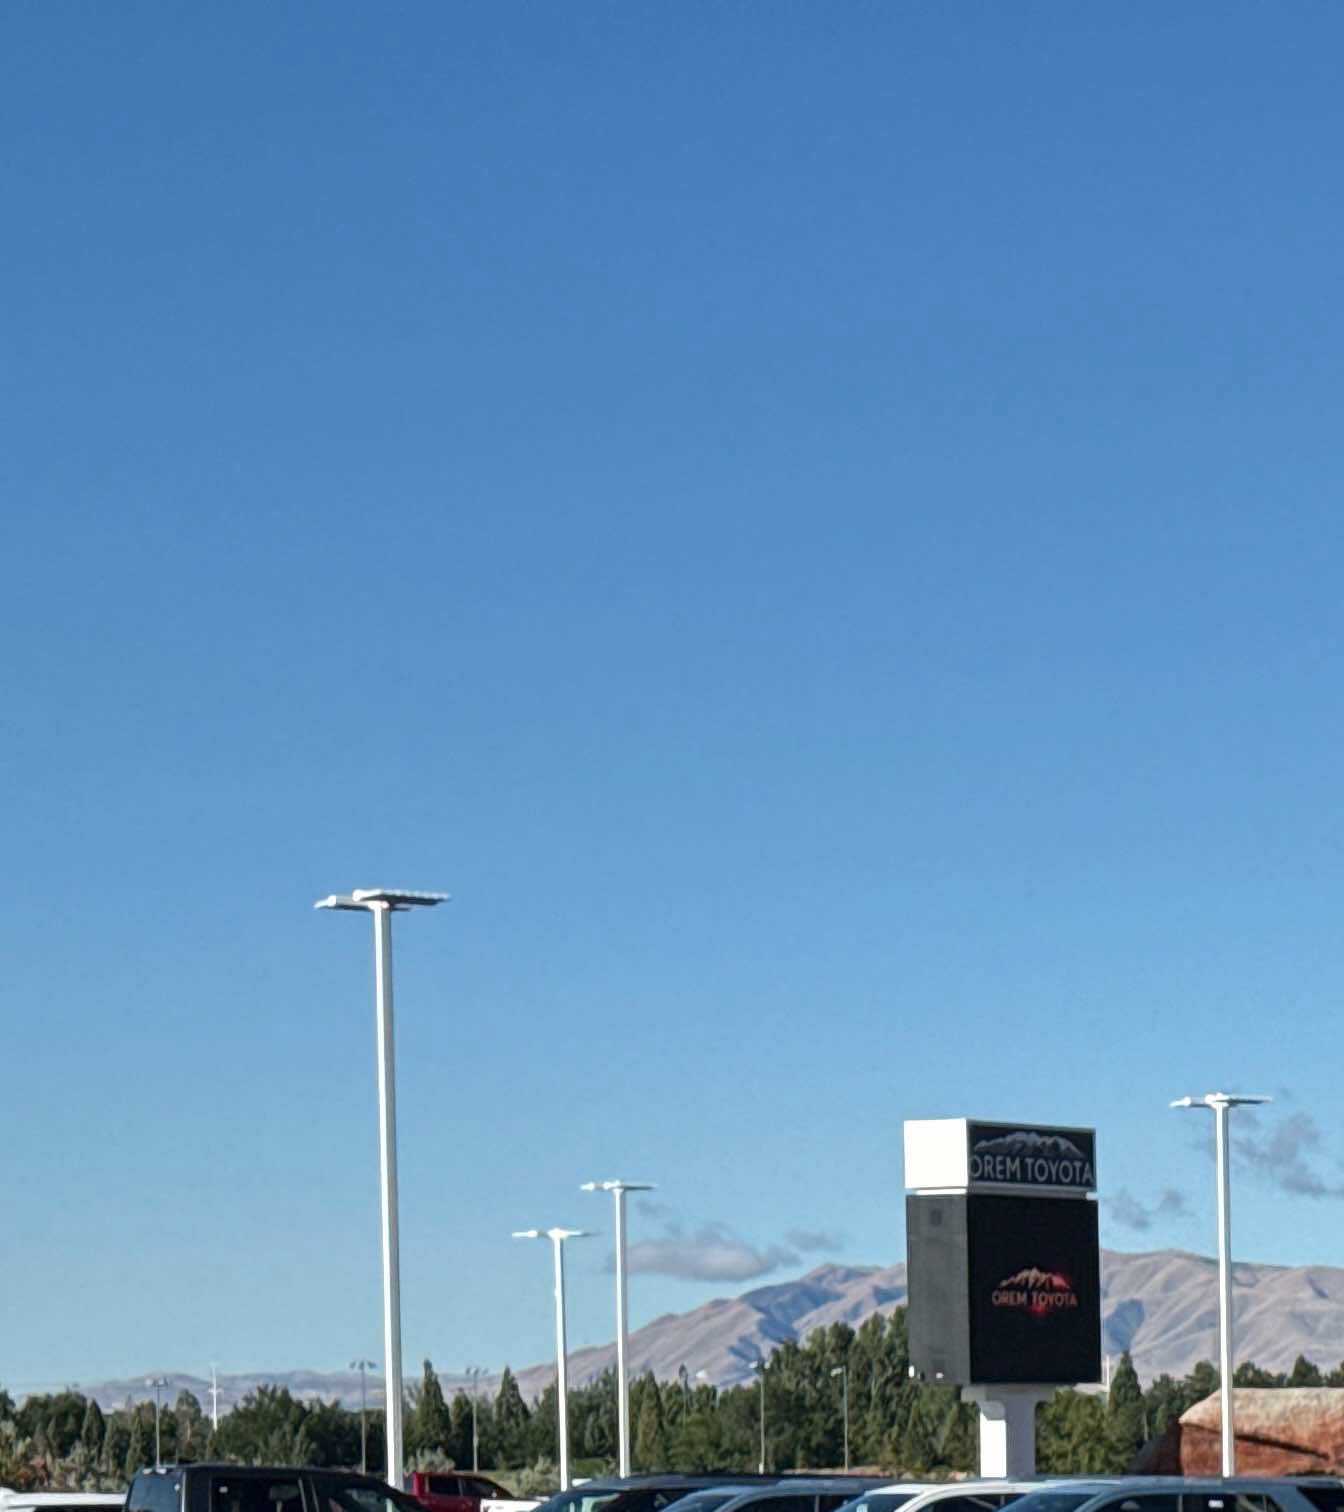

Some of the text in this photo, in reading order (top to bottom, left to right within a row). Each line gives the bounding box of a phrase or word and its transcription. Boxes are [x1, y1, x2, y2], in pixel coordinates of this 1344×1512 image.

[968, 1155, 1093, 1184] OREM TOYOTA
[1031, 1291, 1078, 1307] TOYOTA
